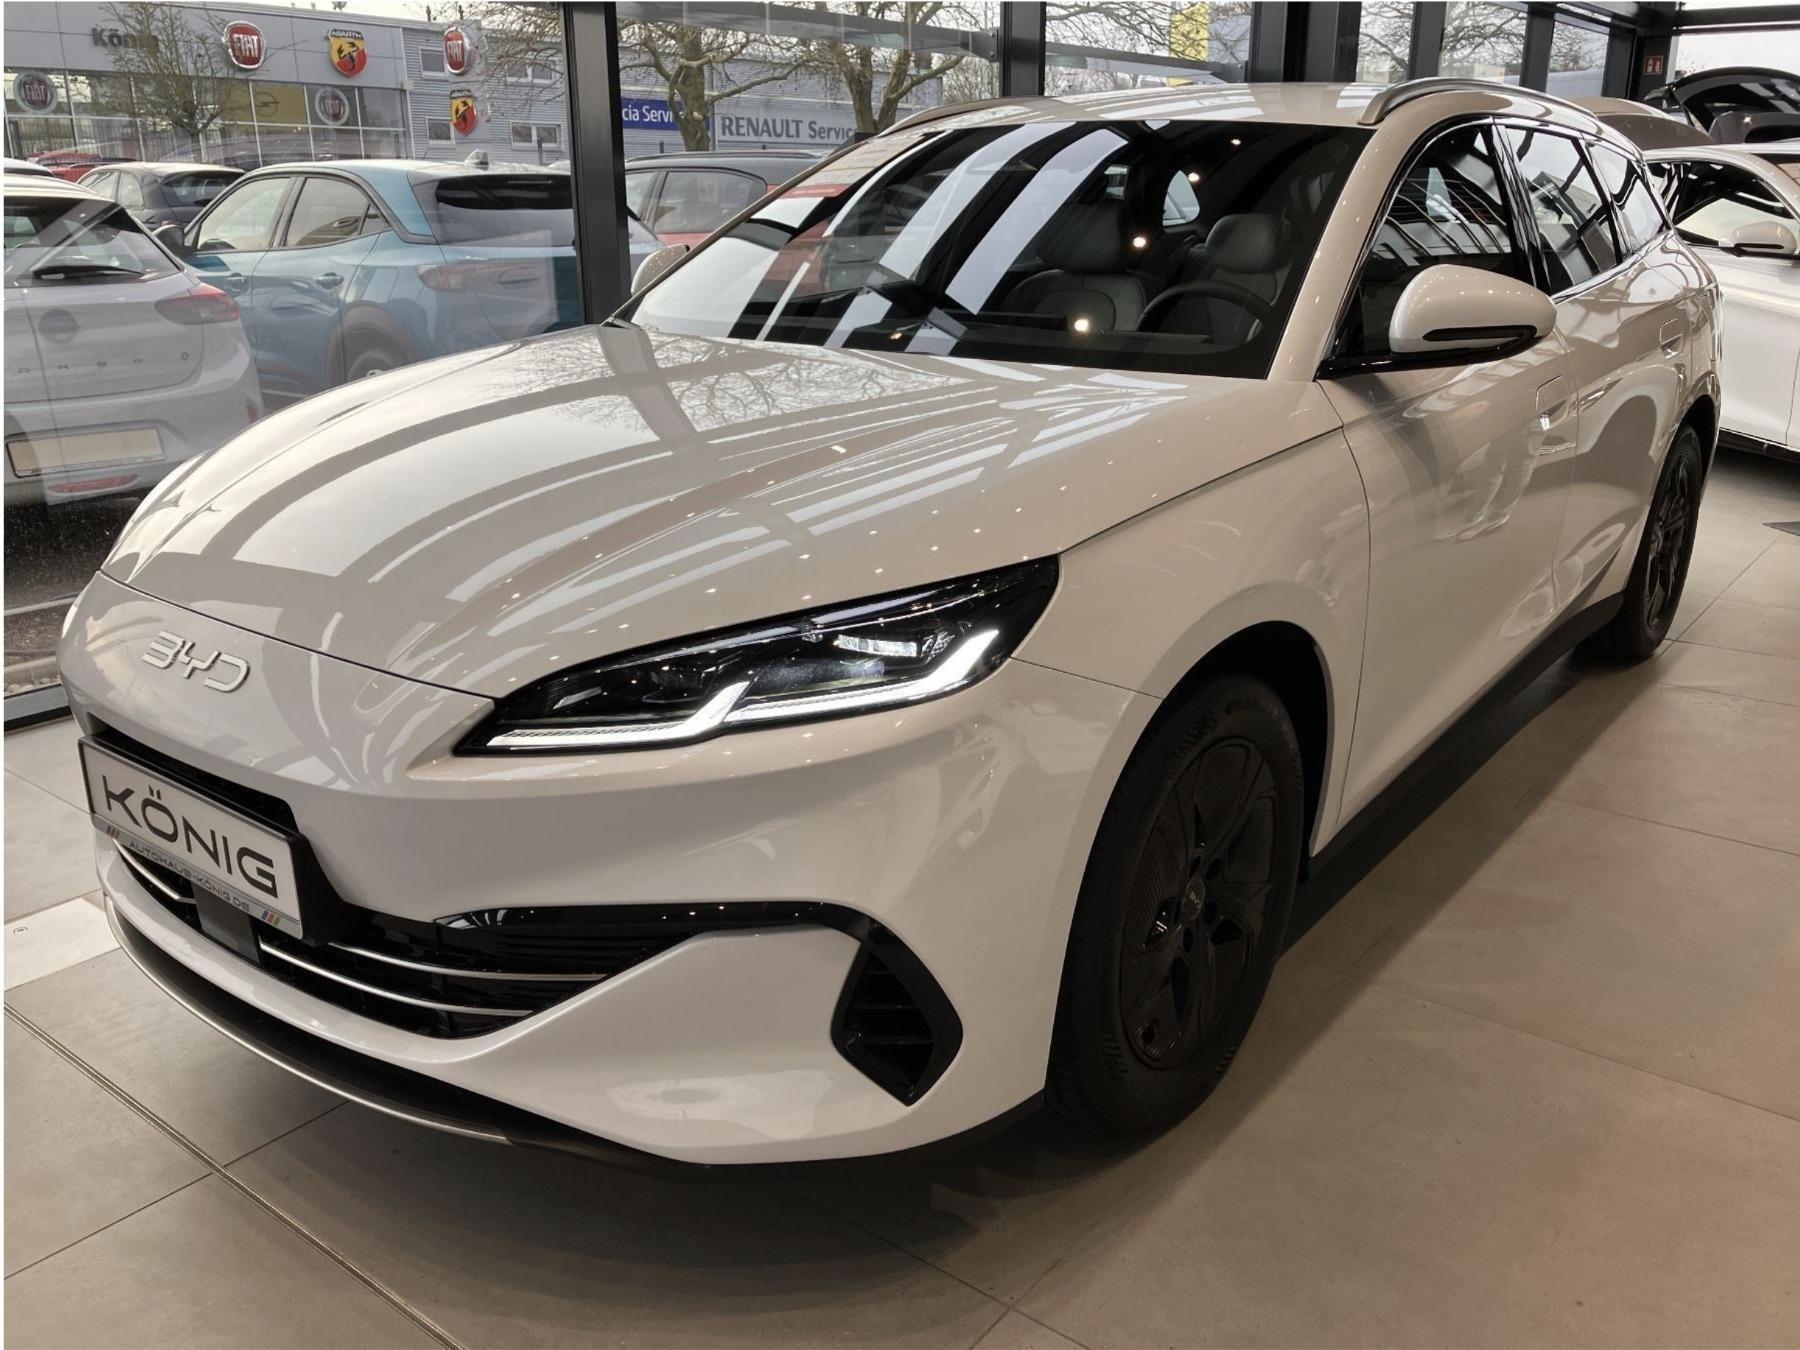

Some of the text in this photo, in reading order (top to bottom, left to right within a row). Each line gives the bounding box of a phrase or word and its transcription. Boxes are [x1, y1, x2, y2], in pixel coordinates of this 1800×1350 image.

[91, 27, 159, 53] Kön
[233, 33, 259, 58] FIAT
[330, 29, 362, 39] ABARTH
[446, 39, 463, 61] FIAT
[622, 104, 684, 123] cia Servi
[720, 116, 857, 140] RENAULT Servic
[142, 630, 250, 693] BYD
[102, 774, 278, 899] KÖNIG
